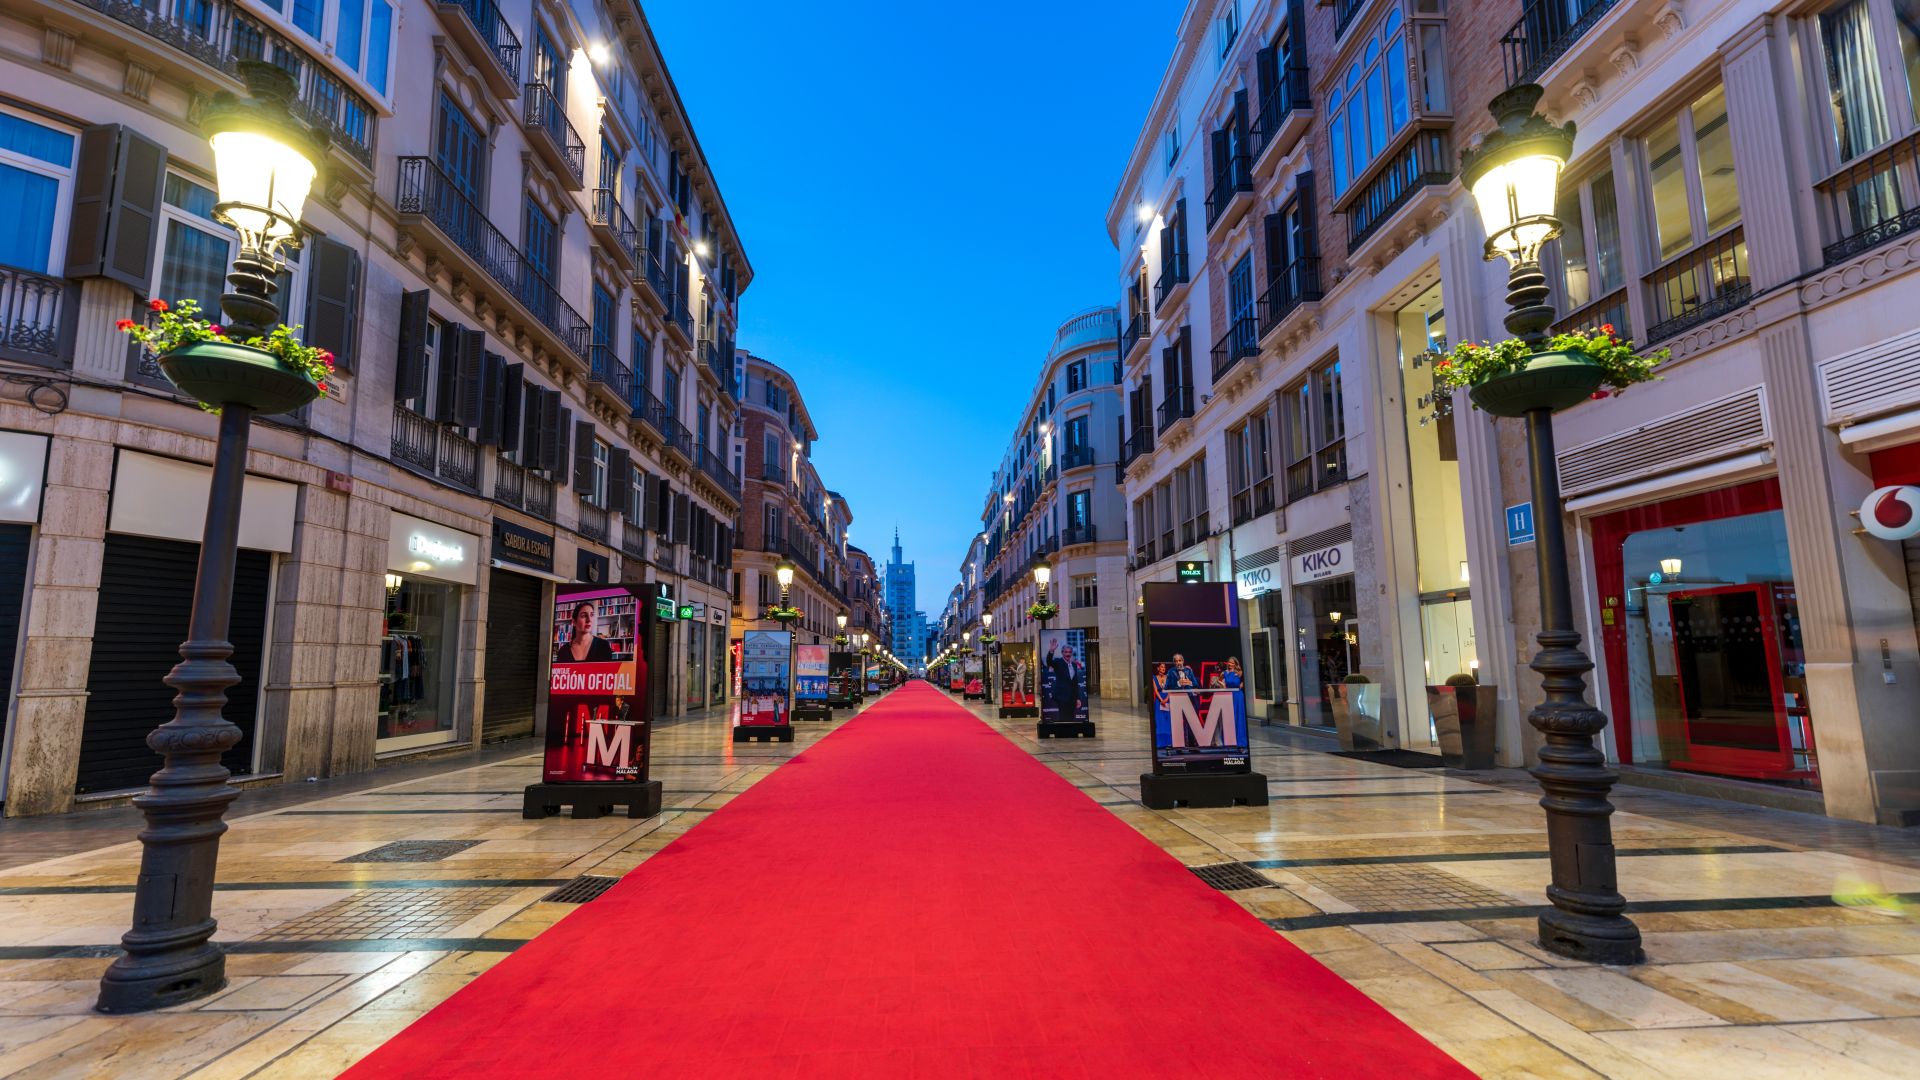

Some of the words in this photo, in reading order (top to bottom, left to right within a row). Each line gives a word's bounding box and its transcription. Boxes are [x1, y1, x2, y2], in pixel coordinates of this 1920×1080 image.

[1514, 511, 1525, 530] H
[504, 532, 526, 551] SABOR
[526, 539, 531, 552] A
[1302, 547, 1341, 573] KIKO
[1242, 567, 1271, 588] KIKO
[588, 673, 633, 691] OFICIAL
[1169, 692, 1238, 749] M
[586, 723, 632, 769] M
